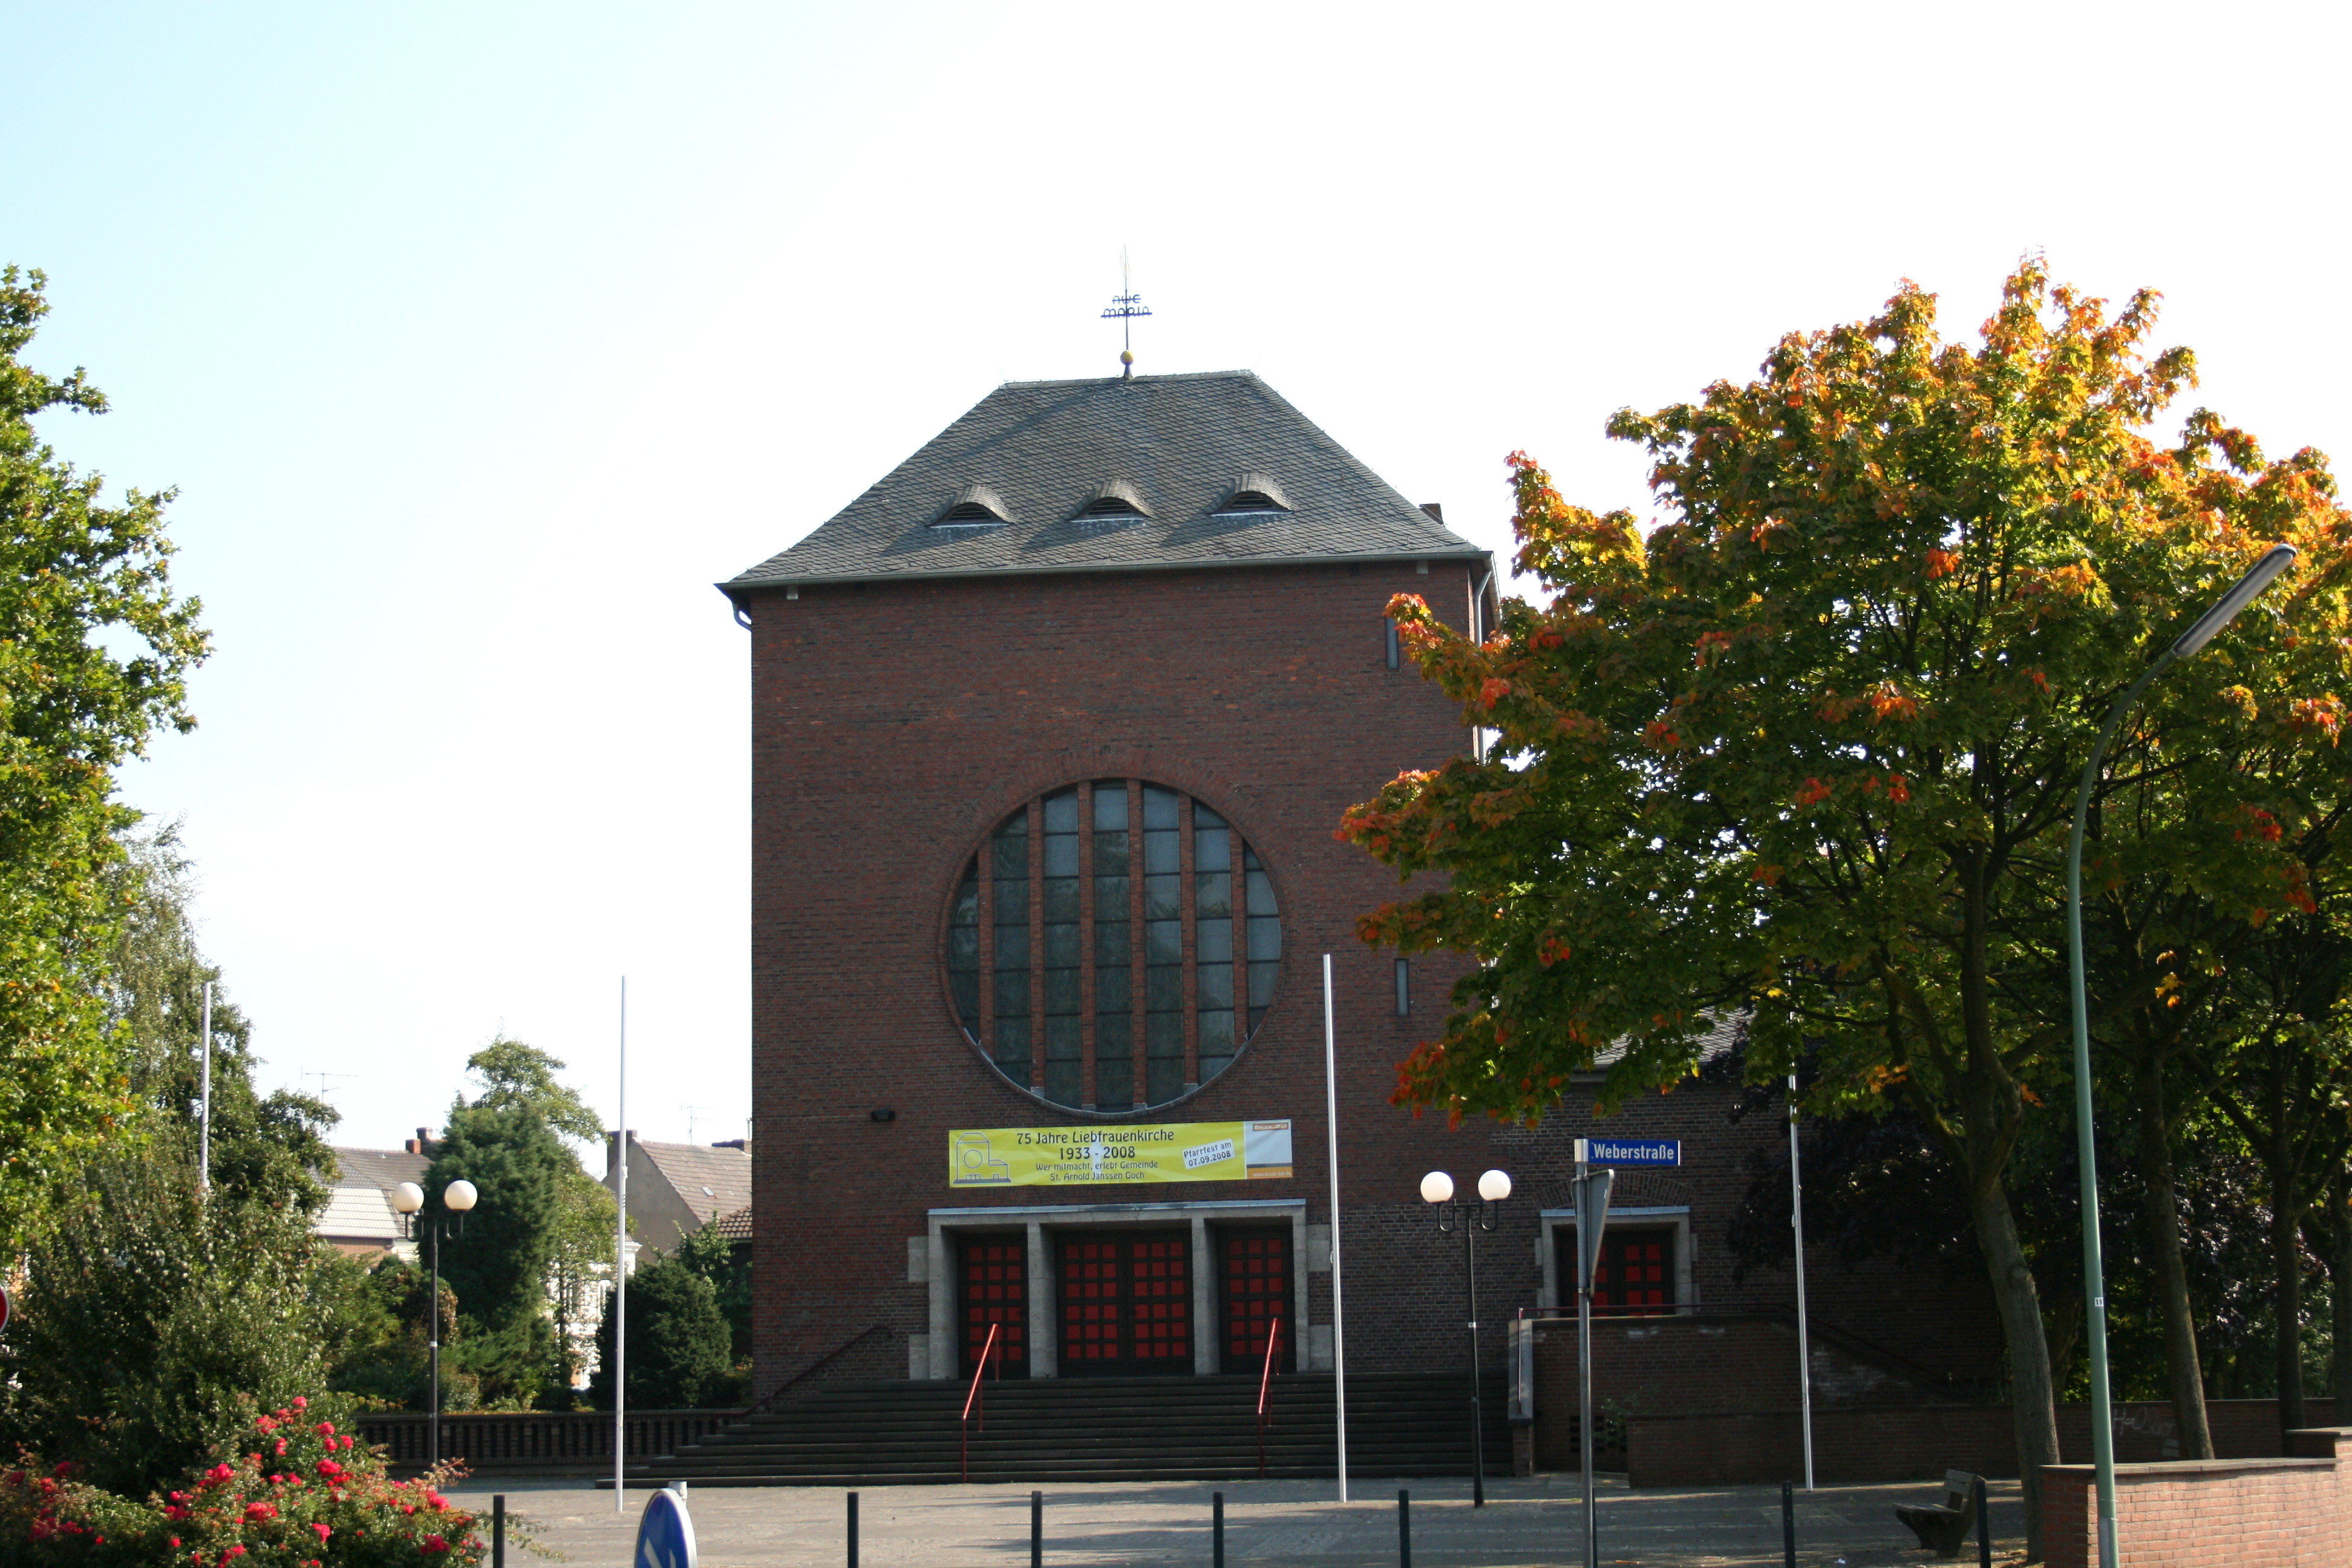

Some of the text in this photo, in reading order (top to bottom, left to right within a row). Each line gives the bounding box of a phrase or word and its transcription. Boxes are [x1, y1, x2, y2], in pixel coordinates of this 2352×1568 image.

[1017, 1129, 1174, 1145] 75 Jahre Liebfrauenkirche
[1059, 1147, 1091, 1160] 1933
[1103, 1146, 1135, 1158] 2008
[1183, 1144, 1218, 1158] Pfarrfest
[1188, 1150, 1232, 1166] 07.09.2008
[1593, 1143, 1674, 1160] Weberstraße
[1120, 1160, 1158, 1169] Gemeinde
[1063, 1172, 1089, 1180] Arnold
[1125, 1171, 1145, 1179] Goch
